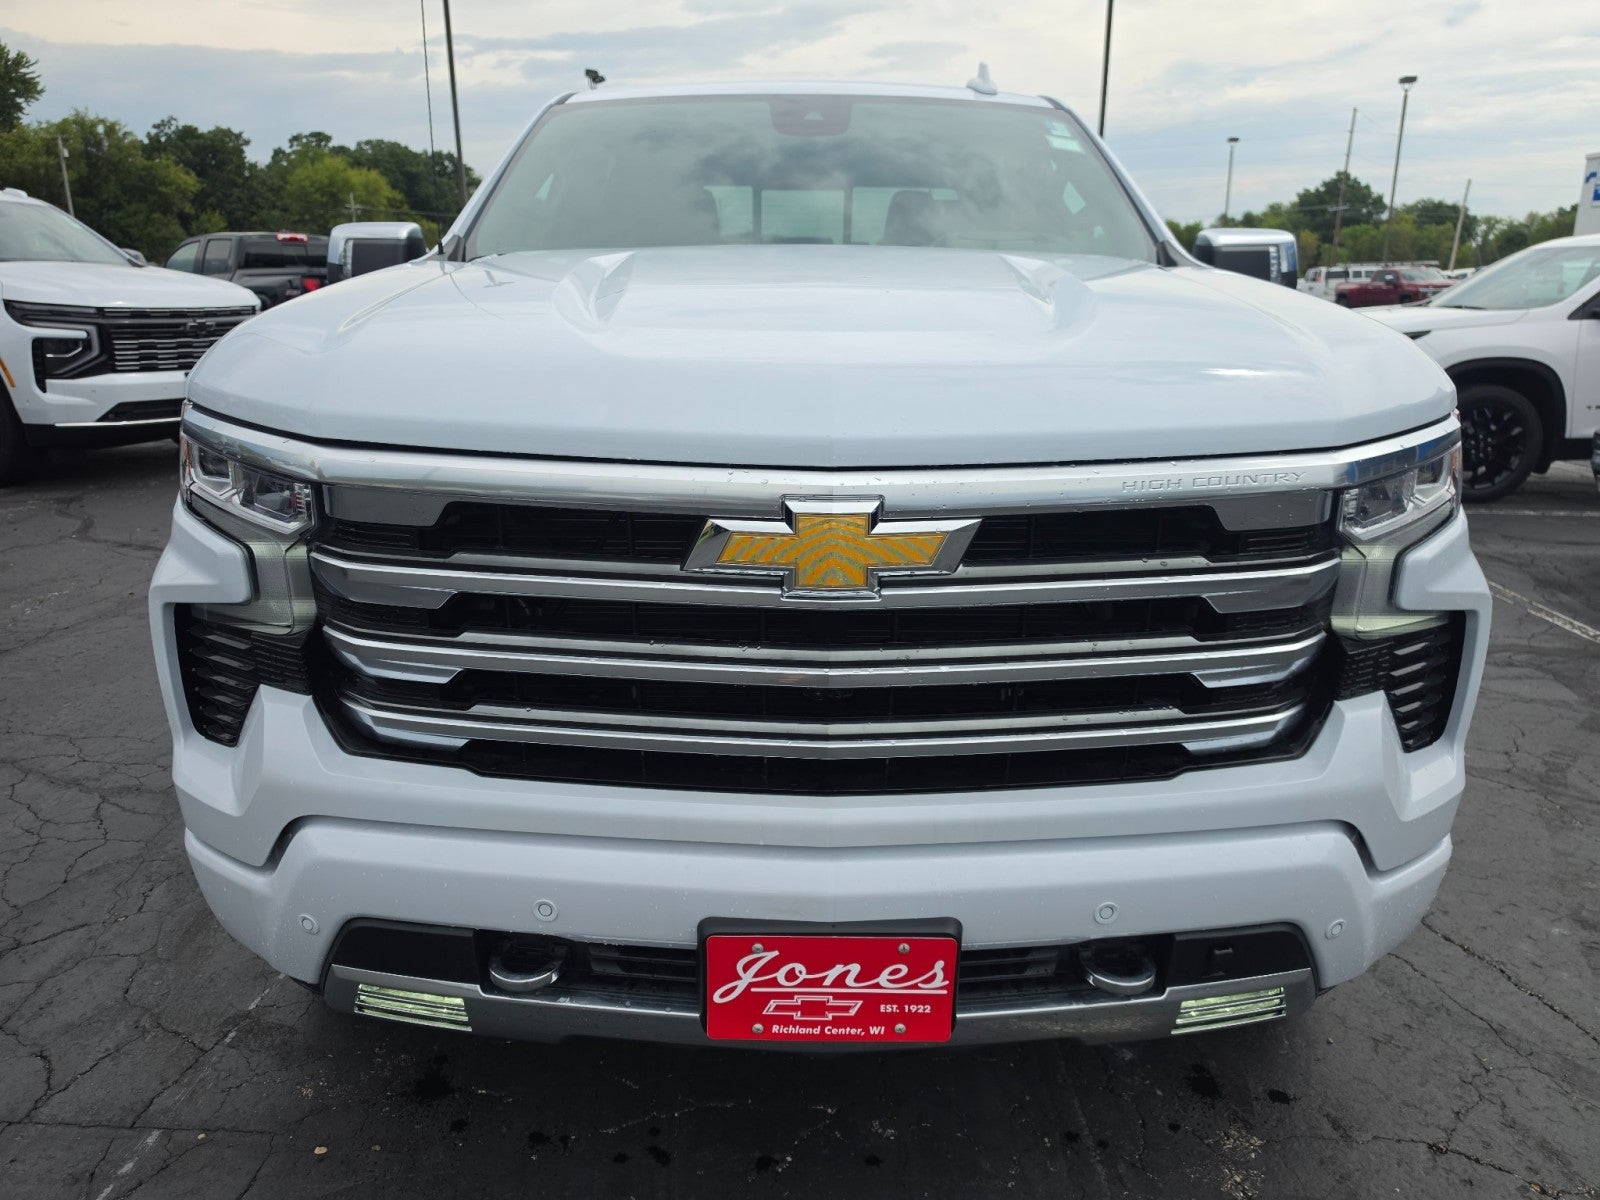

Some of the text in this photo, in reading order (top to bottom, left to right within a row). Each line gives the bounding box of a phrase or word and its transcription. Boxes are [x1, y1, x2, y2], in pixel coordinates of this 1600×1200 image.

[1121, 471, 1307, 493] HIGH COUNTRY
[712, 950, 950, 1004] Jones
[879, 1004, 931, 1014] EST. 1922
[771, 1024, 885, 1037] Richland Center, WI
